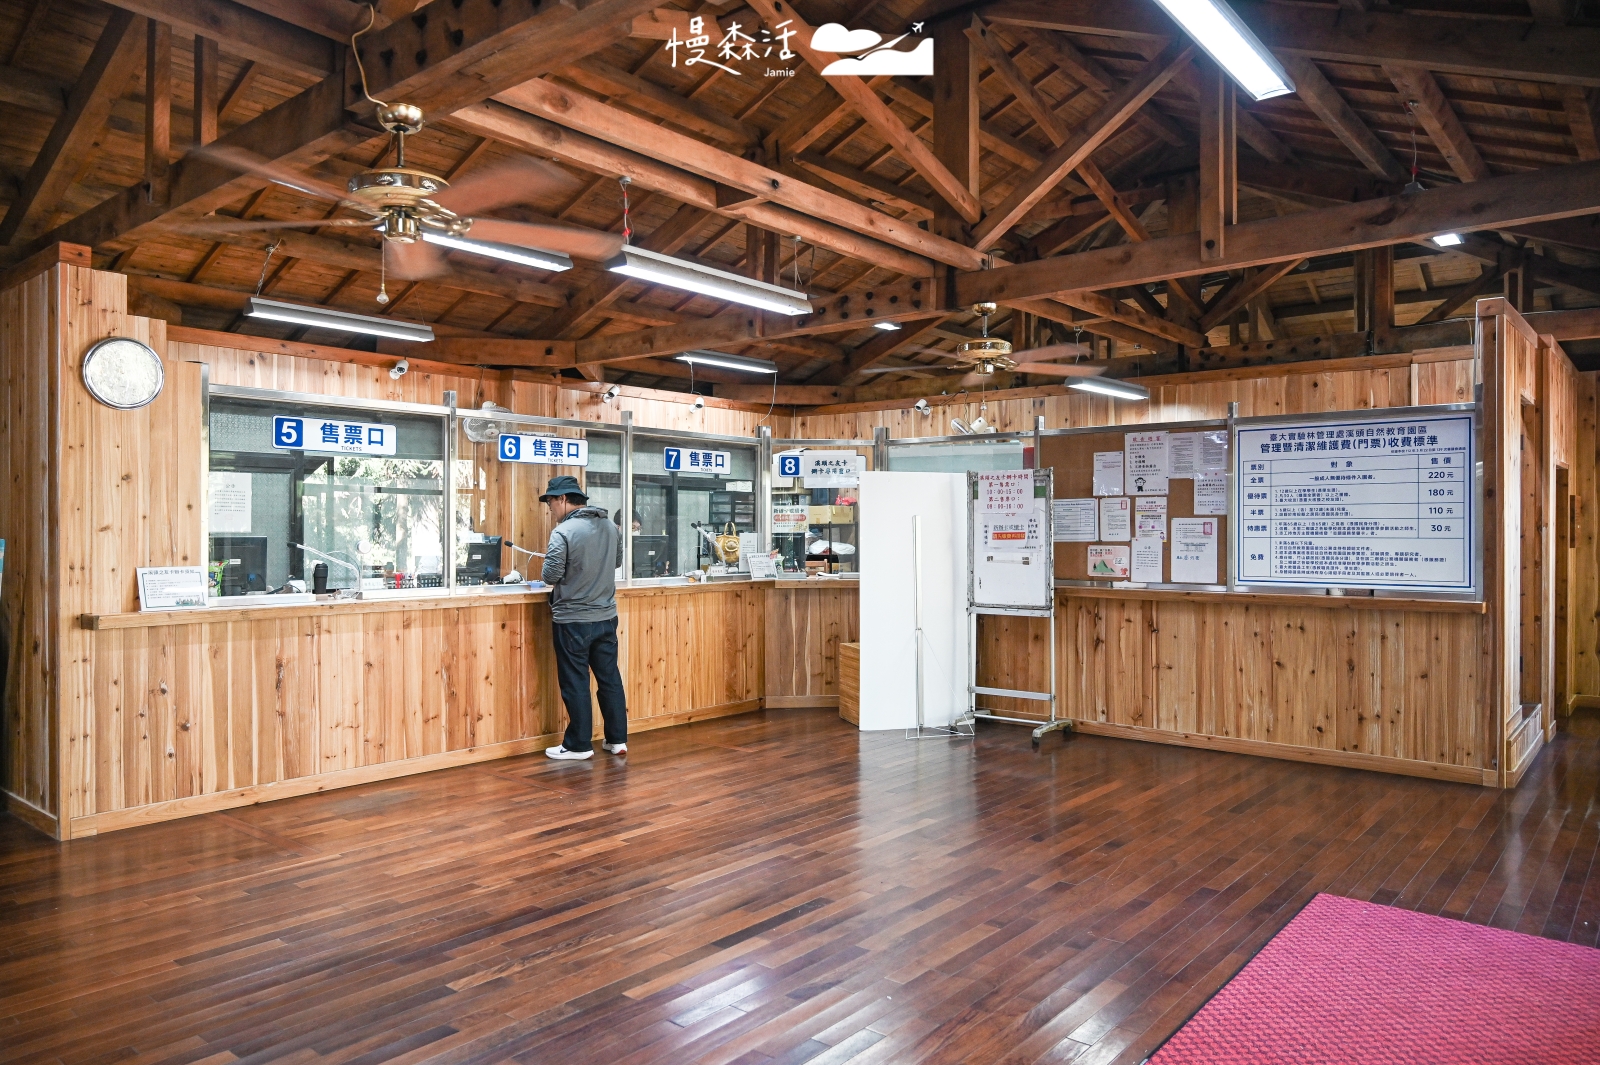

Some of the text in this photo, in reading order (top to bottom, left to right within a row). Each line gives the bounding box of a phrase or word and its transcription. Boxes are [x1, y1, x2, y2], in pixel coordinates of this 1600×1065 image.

[280, 421, 298, 444] 5
[320, 423, 384, 446] 售票口
[1270, 426, 1427, 442] 臺大實驗林管理處溪頭自然教育園區
[504, 438, 516, 456] 6
[532, 438, 579, 458] 售票口
[668, 452, 678, 468] 7
[689, 451, 724, 468] 售票口
[785, 458, 795, 473] 8
